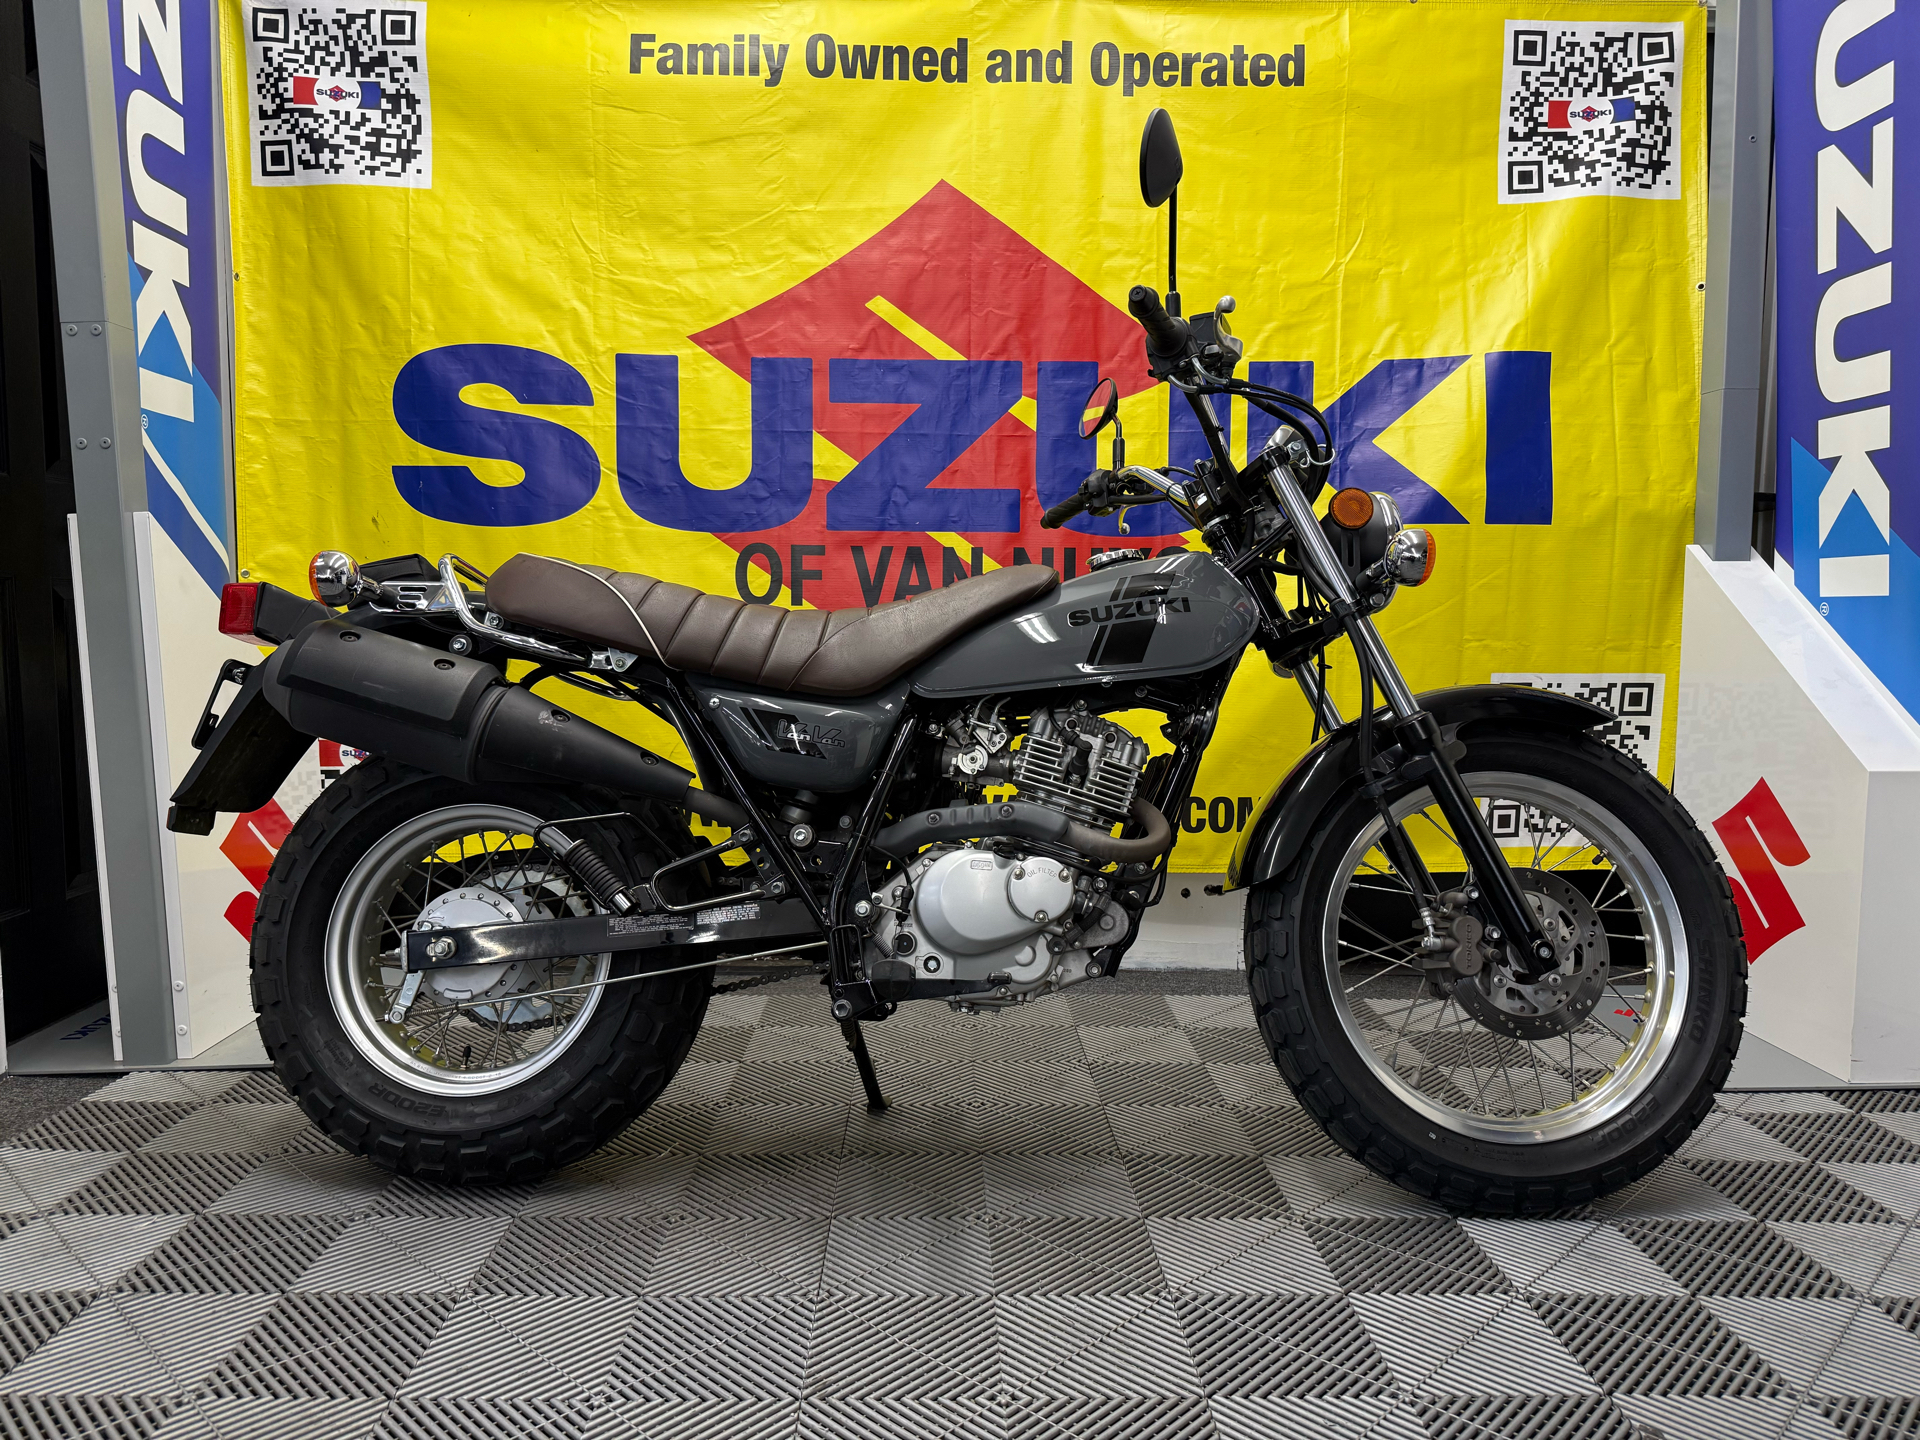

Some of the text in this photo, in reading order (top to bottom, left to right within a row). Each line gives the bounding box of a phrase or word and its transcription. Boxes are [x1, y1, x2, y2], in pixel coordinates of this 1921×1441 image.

[629, 33, 1305, 97] Family Owned and Operated
[316, 88, 359, 99] SUZUKI
[1569, 109, 1612, 120] SUZUKI
[392, 343, 1552, 537] SUZUKI
[735, 542, 826, 606] OF
[1068, 597, 1191, 627] SUZUKI
[1026, 867, 1057, 878] OIL FILTER
